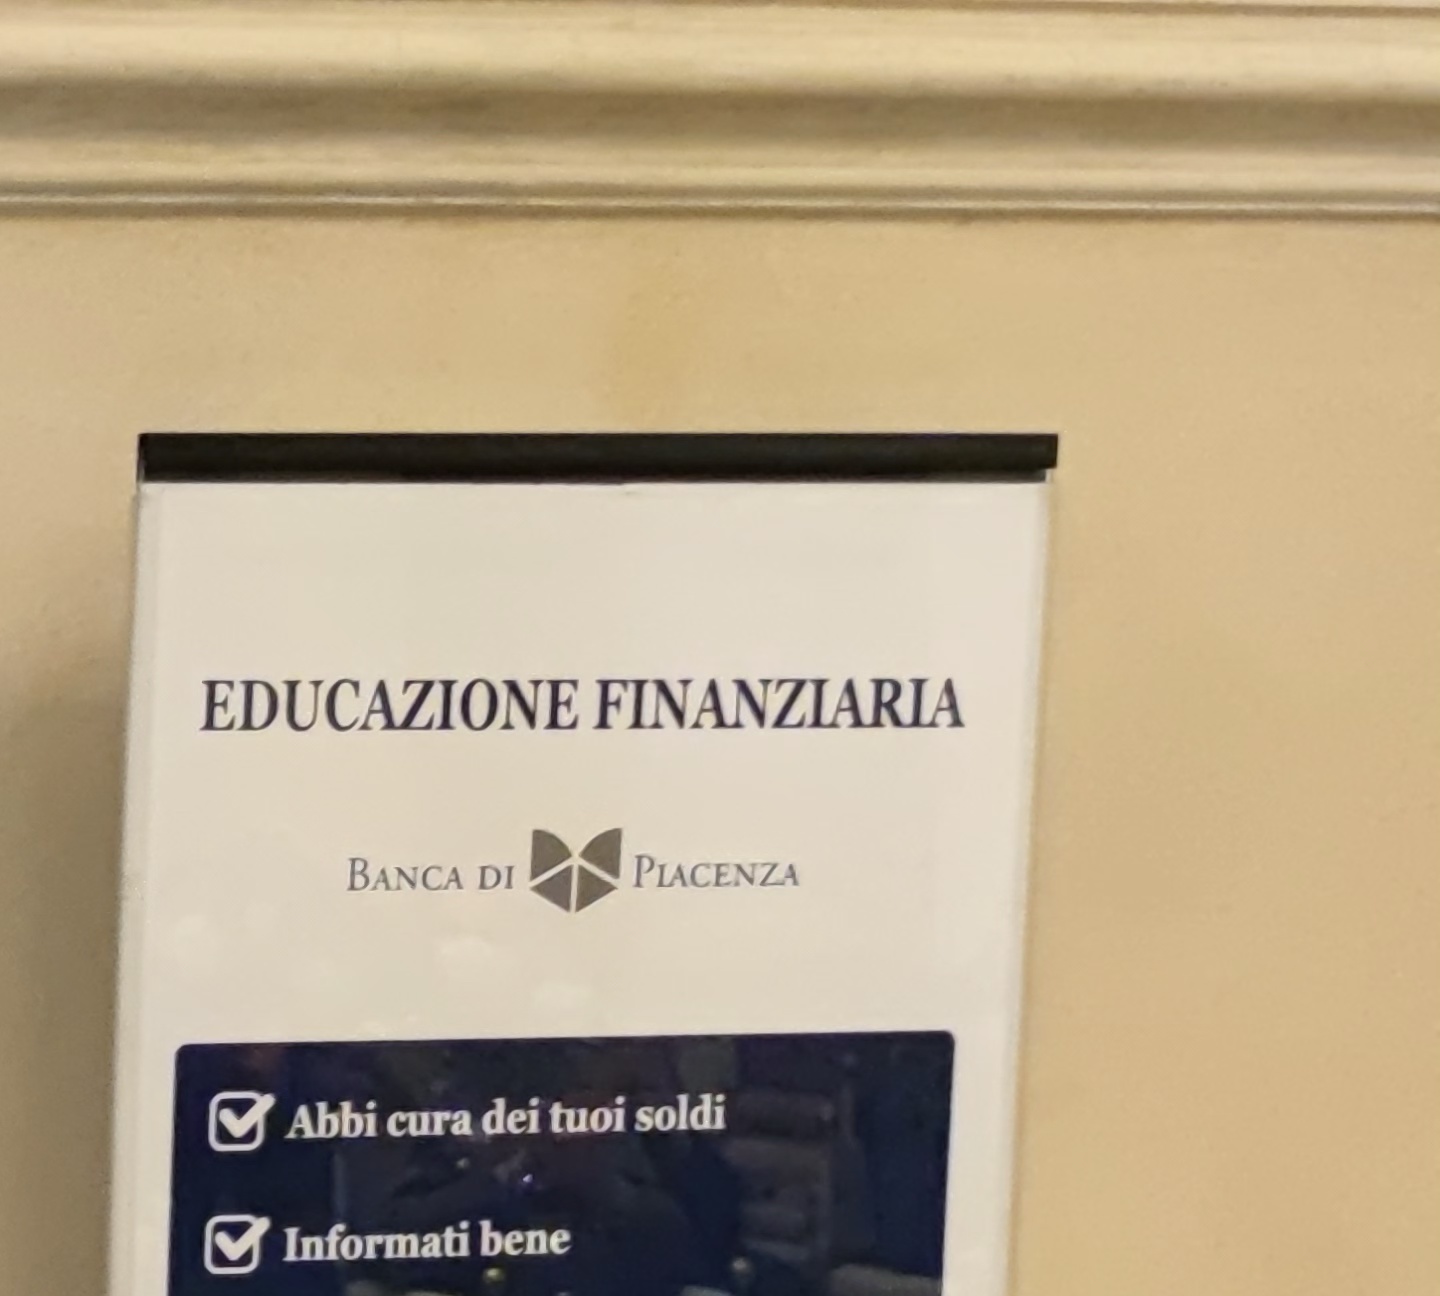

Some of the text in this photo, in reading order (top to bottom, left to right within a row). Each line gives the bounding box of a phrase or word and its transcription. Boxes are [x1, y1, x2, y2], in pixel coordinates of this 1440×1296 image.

[200, 678, 966, 732] EDUCAZIONE FINANZIARIA
[347, 853, 800, 892] BANCA DI PIACENZA
[285, 1092, 727, 1140] Abbi cura dei tuoi soldi
[282, 1218, 572, 1263] Informati bene
